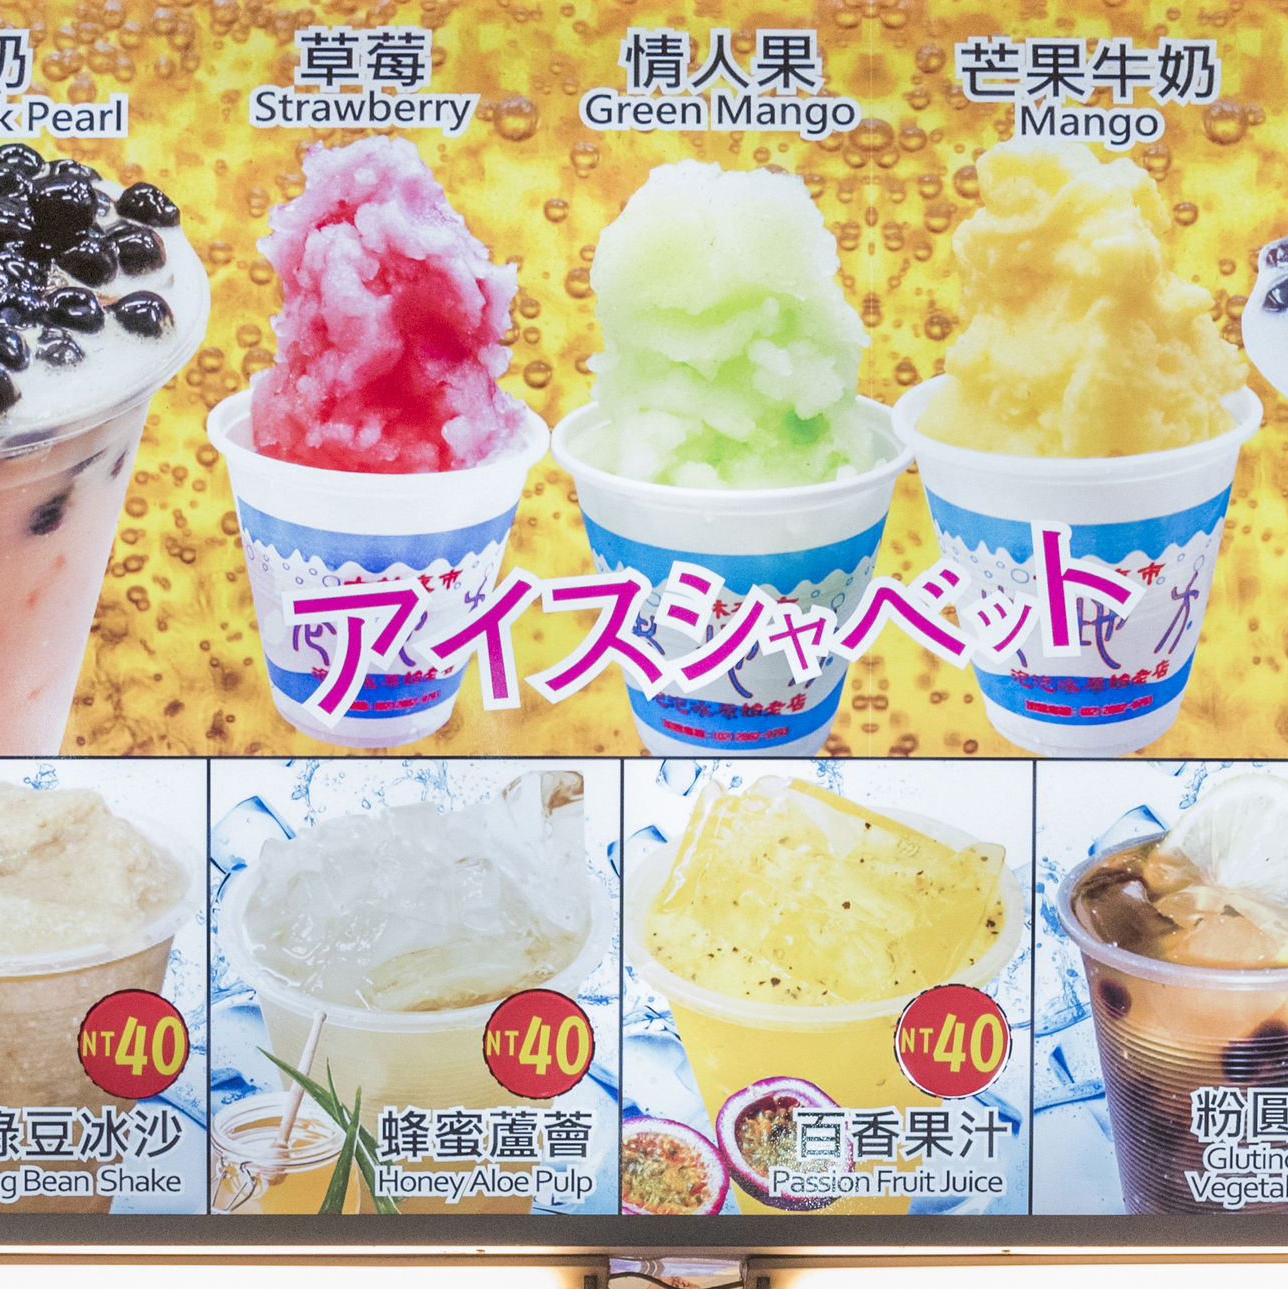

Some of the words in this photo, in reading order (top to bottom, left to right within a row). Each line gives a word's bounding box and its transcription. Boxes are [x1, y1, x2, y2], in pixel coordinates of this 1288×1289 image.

[625, 33, 818, 89] 情人果
[960, 45, 1215, 103] 芒果牛奶
[28, 104, 123, 132] Pearl
[586, 94, 702, 126] Green
[718, 94, 856, 135] Mango
[1021, 105, 1158, 146] Mango
[293, 530, 1135, 715] アイスシャベット
[382, 1108, 593, 1160] 蜂蜜蘆薈
[795, 1111, 1010, 1160] 百香果汁
[25, 1170, 90, 1193] Bean
[100, 1168, 181, 1193] Shake
[379, 1169, 465, 1200] Honey
[469, 1169, 528, 1193] Aloe
[536, 1169, 593, 1200] Pulp
[773, 1169, 870, 1194] Passion
[877, 1169, 937, 1194] Fruit
[940, 1169, 1002, 1194] Juice
